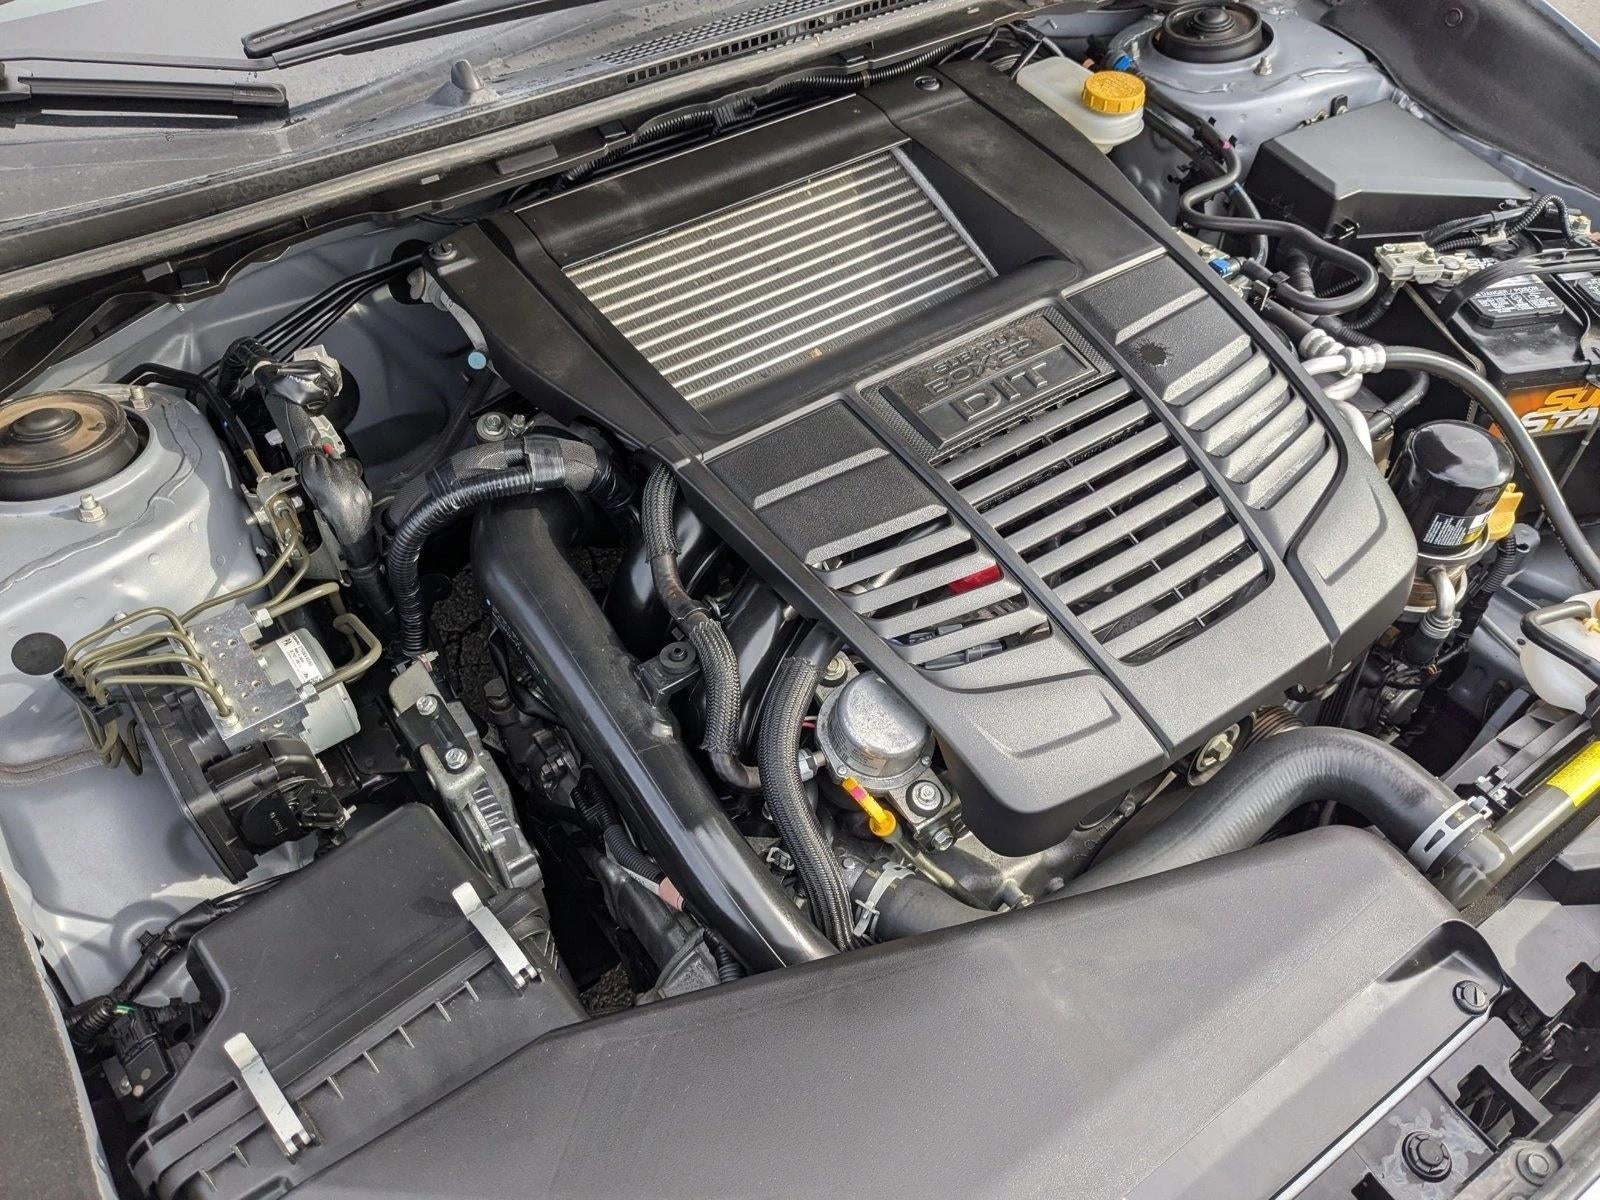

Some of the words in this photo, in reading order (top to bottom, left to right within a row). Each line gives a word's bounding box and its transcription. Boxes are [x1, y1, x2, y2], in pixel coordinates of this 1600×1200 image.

[923, 336, 1038, 395] BOXER
[933, 334, 1009, 373] SUBARU
[948, 361, 1048, 421] DIT
